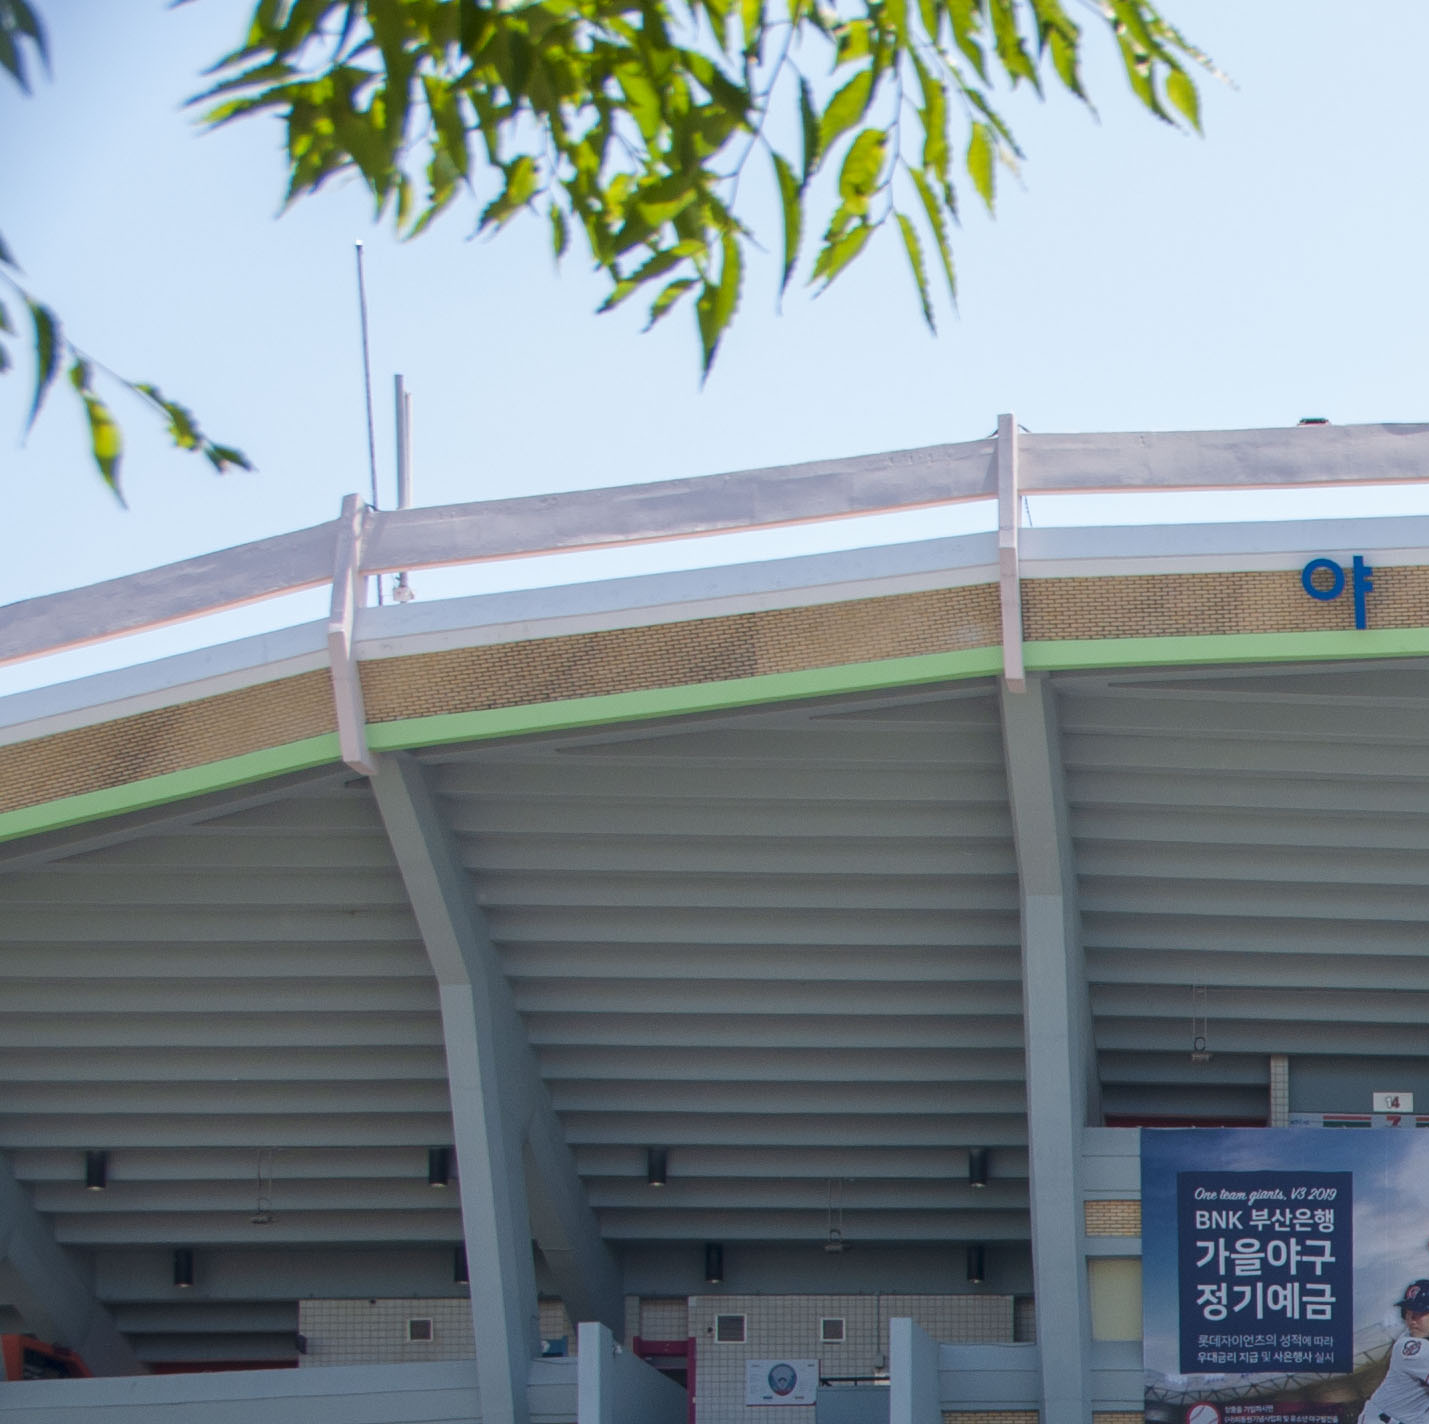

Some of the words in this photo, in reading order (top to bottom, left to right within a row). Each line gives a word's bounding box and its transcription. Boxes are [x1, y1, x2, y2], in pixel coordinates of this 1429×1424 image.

[1302, 556, 1373, 629] 야
[1194, 1187, 1218, 1200] One
[1219, 1188, 1247, 1200] team
[1249, 1188, 1287, 1206] giants,
[1290, 1187, 1307, 1200] V3
[1307, 1188, 1338, 1201] 2019
[1196, 1210, 1244, 1229] BNK
[1249, 1208, 1335, 1232] 부산은행
[1196, 1238, 1336, 1276] 가을야구
[1196, 1282, 1337, 1321] 정기예금
[1198, 1334, 1277, 1348] 롯데자이언츠의
[1279, 1334, 1312, 1348] 성적에
[1313, 1335, 1334, 1347] 따라
[1197, 1351, 1237, 1364] 우대금리
[1239, 1352, 1259, 1363] 지급
[1260, 1352, 1271, 1363] 및
[1272, 1351, 1313, 1363] 사은행사
[1314, 1352, 1334, 1363] 실시
